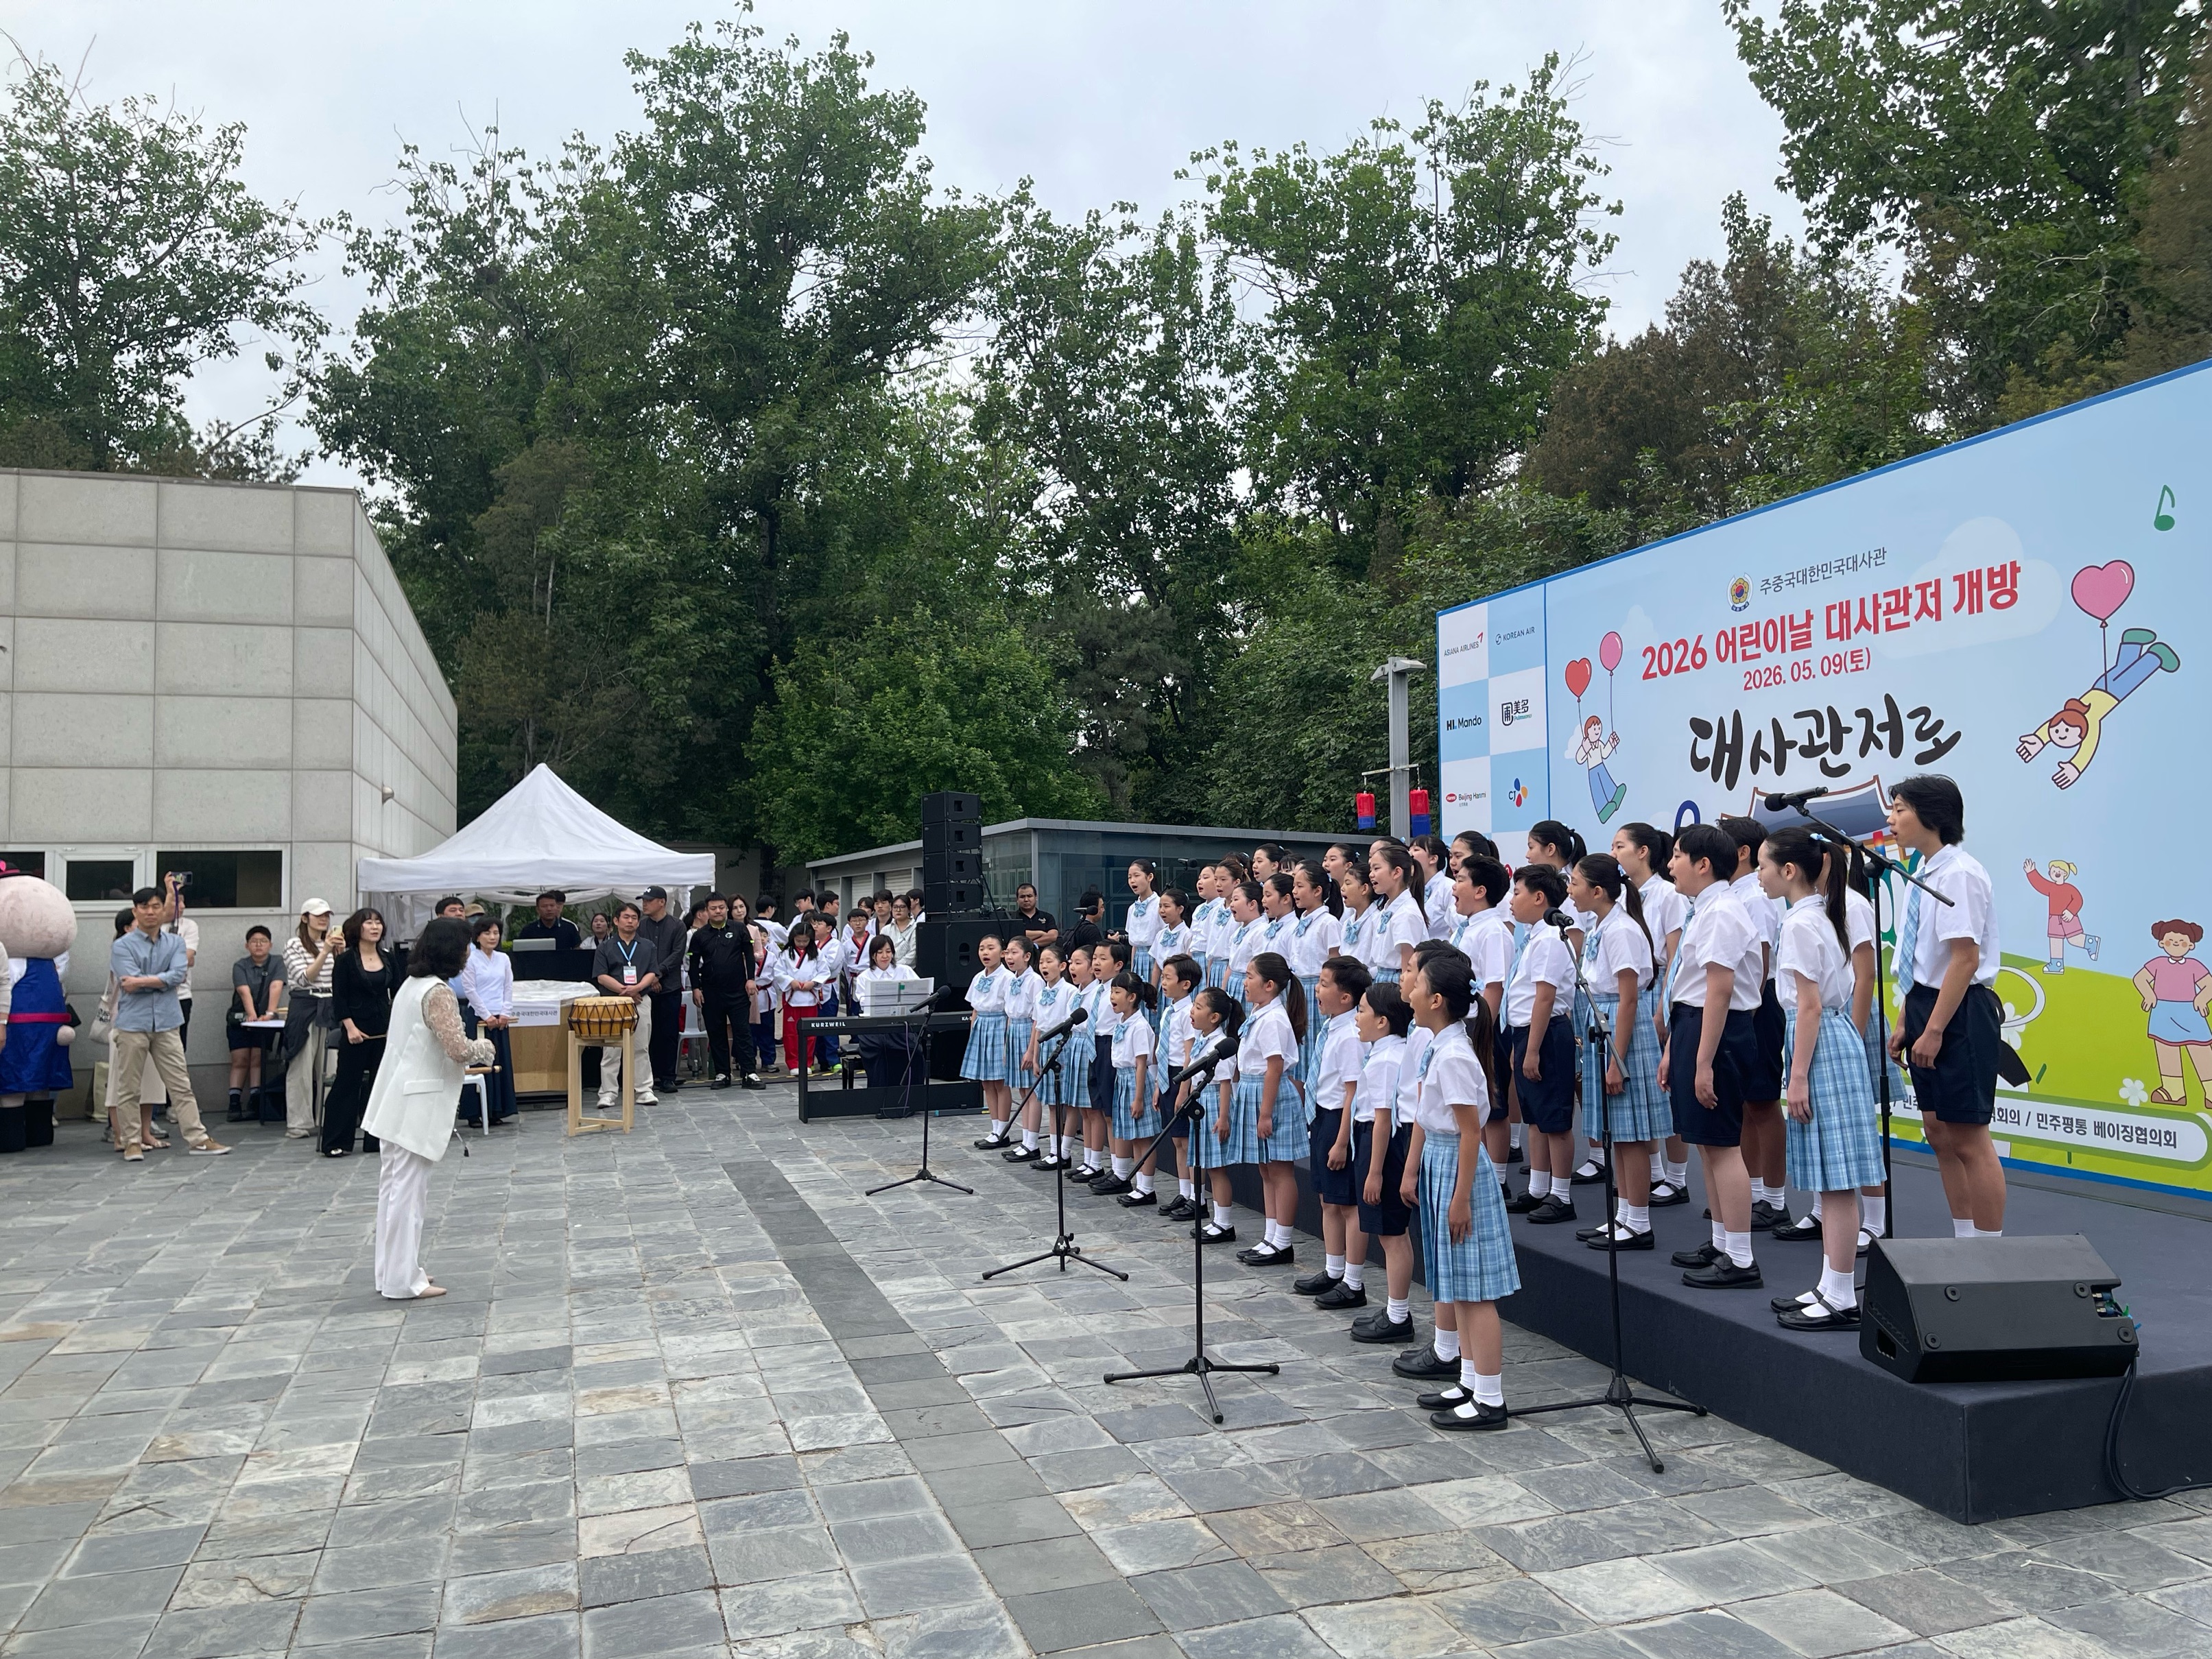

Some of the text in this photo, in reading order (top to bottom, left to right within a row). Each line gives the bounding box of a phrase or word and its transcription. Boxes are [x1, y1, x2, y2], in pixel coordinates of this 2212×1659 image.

[1759, 547, 1887, 595] 주중국대한민국대사관
[1503, 626, 1535, 641] KOREAN AIR
[1641, 560, 2021, 680] 2026 어린이날 대사관저 개방
[1444, 641, 1479, 656] ASIANA AIRLINES
[1743, 646, 1871, 691] 2026. 05. 09(토)
[1458, 715, 1482, 728] Mando
[1689, 693, 1962, 791] 대사관저로
[1508, 790, 1516, 802] CJ
[2036, 1112, 2088, 1136] 민주평통
[2093, 1120, 2178, 1149] 베이징협의회
